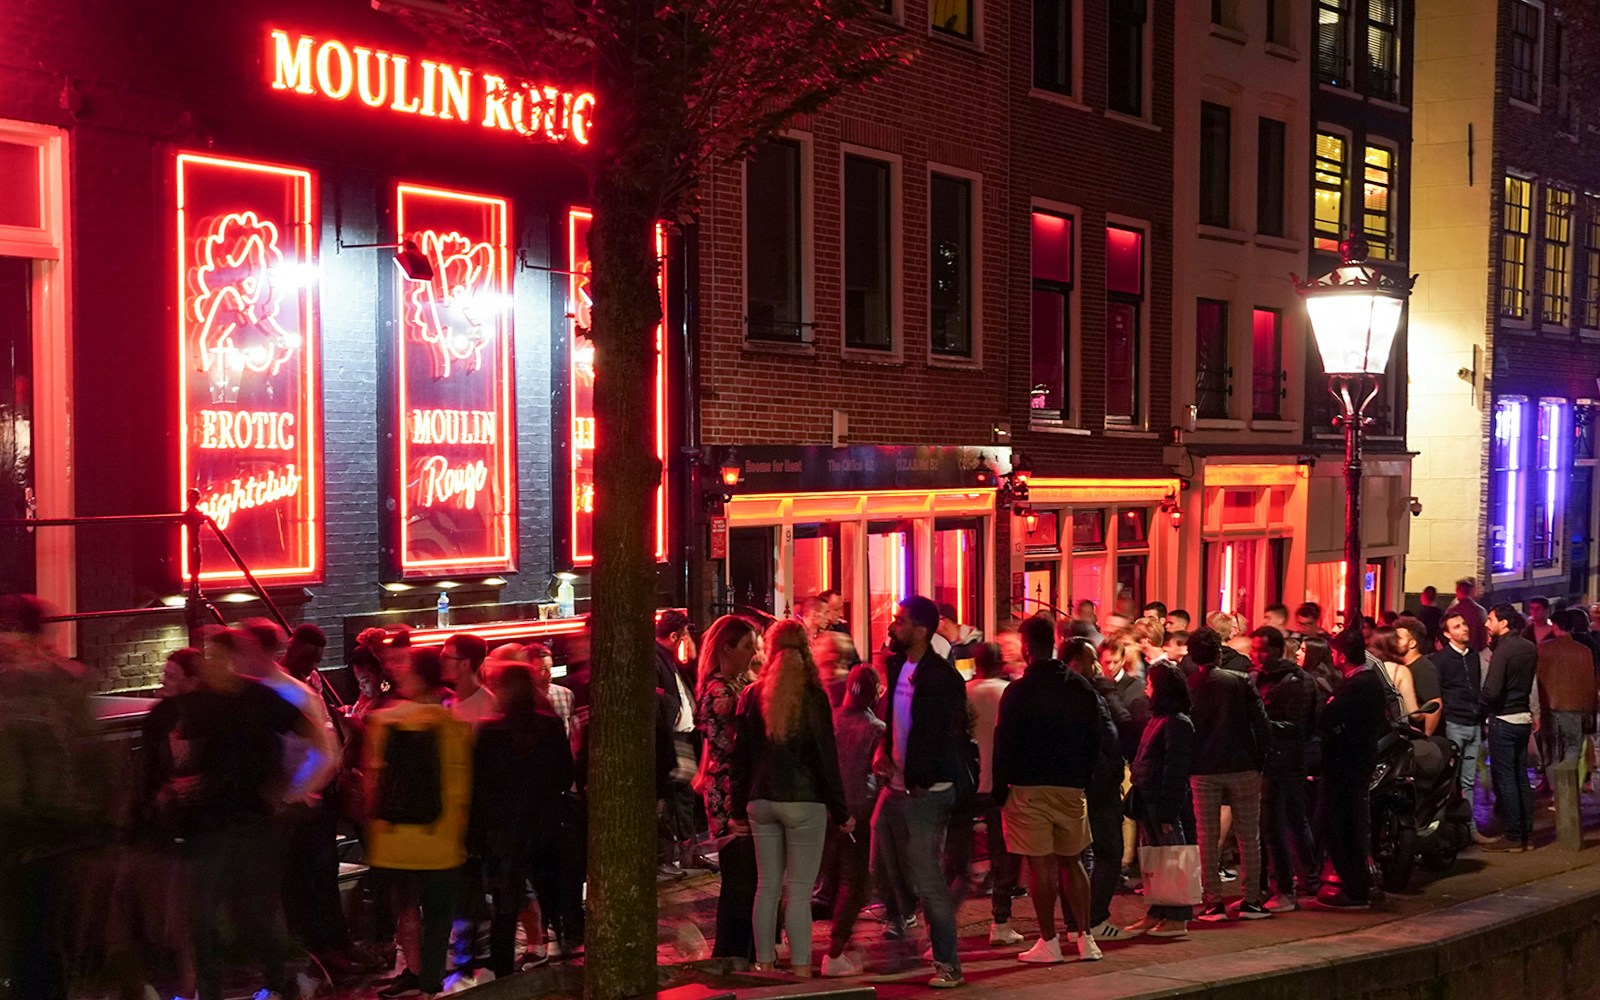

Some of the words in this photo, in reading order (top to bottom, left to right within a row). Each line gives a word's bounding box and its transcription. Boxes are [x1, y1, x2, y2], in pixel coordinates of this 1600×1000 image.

[271, 29, 472, 123] MOULIN
[200, 409, 295, 450] EROTIC
[412, 409, 496, 445] MOULIN
[423, 455, 488, 510] Rouge
[785, 530, 792, 542] 9
